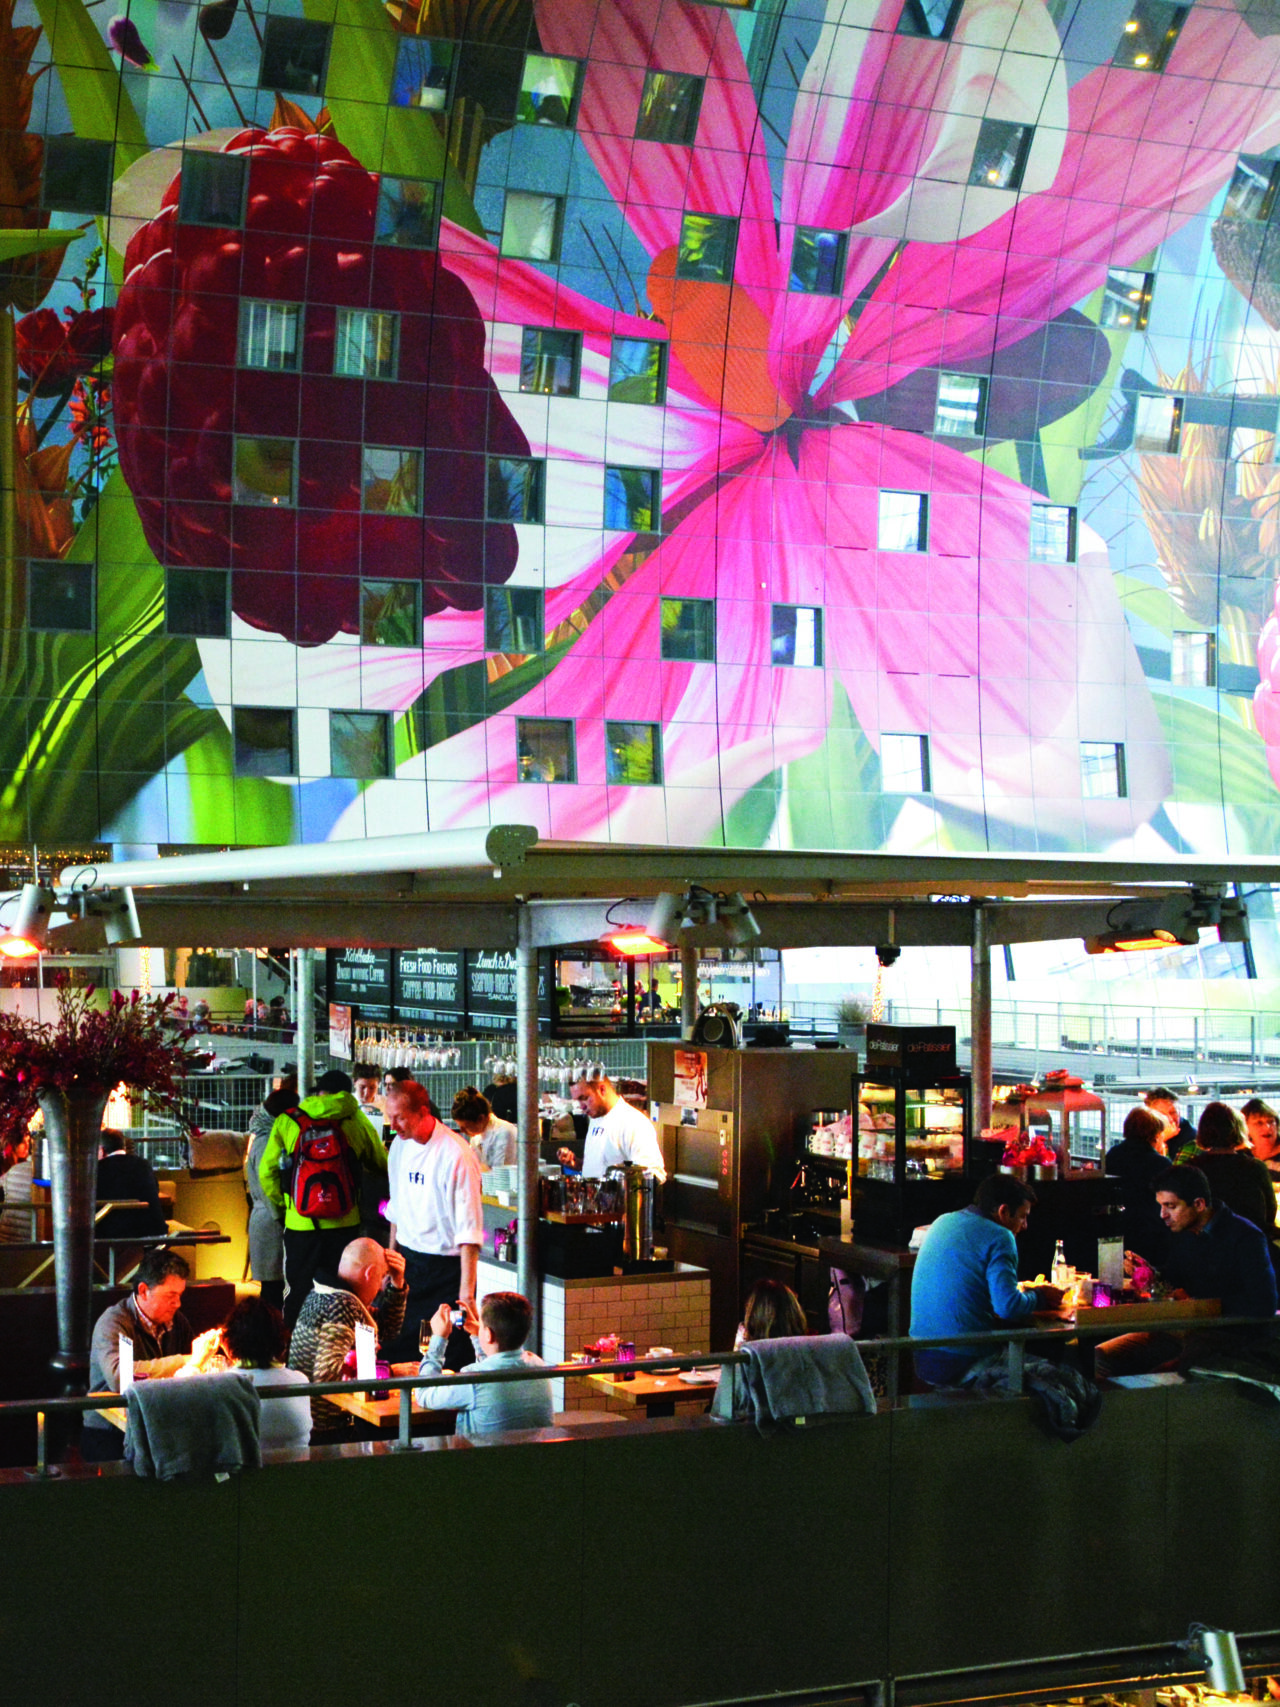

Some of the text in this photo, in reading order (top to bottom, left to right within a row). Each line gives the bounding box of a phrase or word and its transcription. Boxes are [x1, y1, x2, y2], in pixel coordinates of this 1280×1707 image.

[399, 956, 458, 976] FRESH FOOD FRIENDS
[476, 950, 498, 969] Lunch
